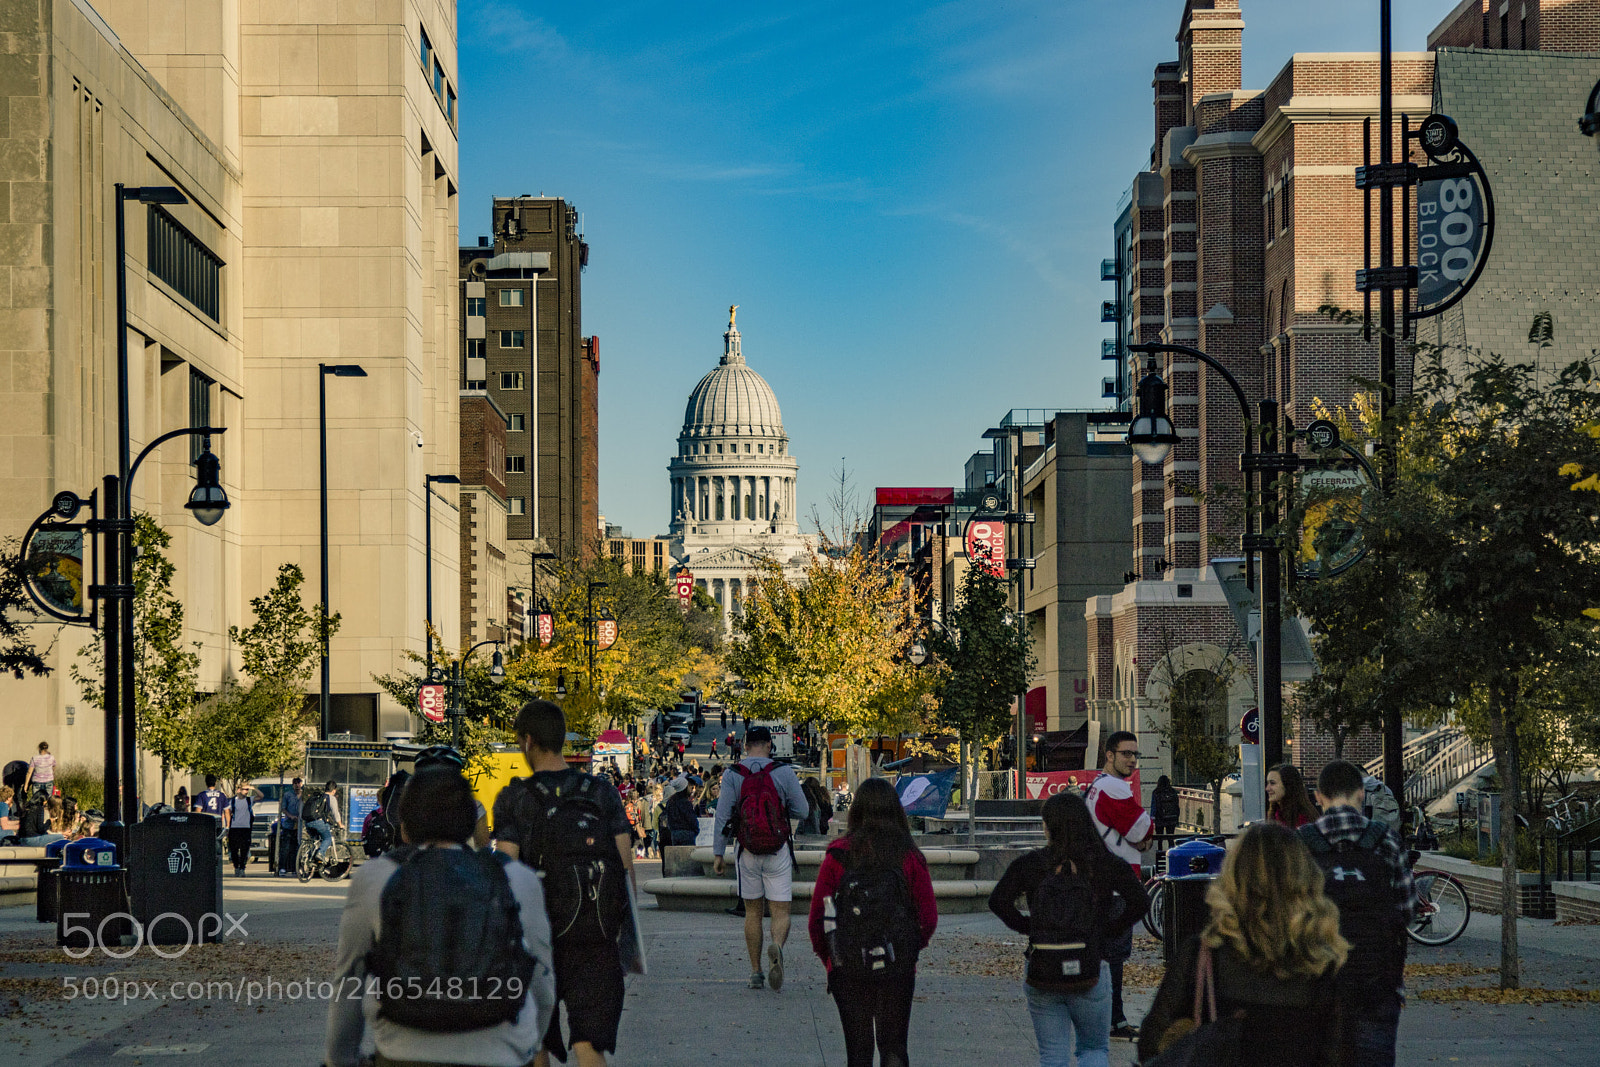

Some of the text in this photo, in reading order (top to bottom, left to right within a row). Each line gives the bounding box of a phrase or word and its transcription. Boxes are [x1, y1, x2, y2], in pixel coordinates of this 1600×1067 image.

[1419, 201, 1439, 284] BLOCK
[1440, 178, 1475, 281] 800
[1310, 477, 1358, 486] CELEBRATE
[604, 620, 616, 645] 600
[422, 686, 436, 716] 700
[435, 691, 444, 717] BLOCK
[207, 796, 218, 810] 4
